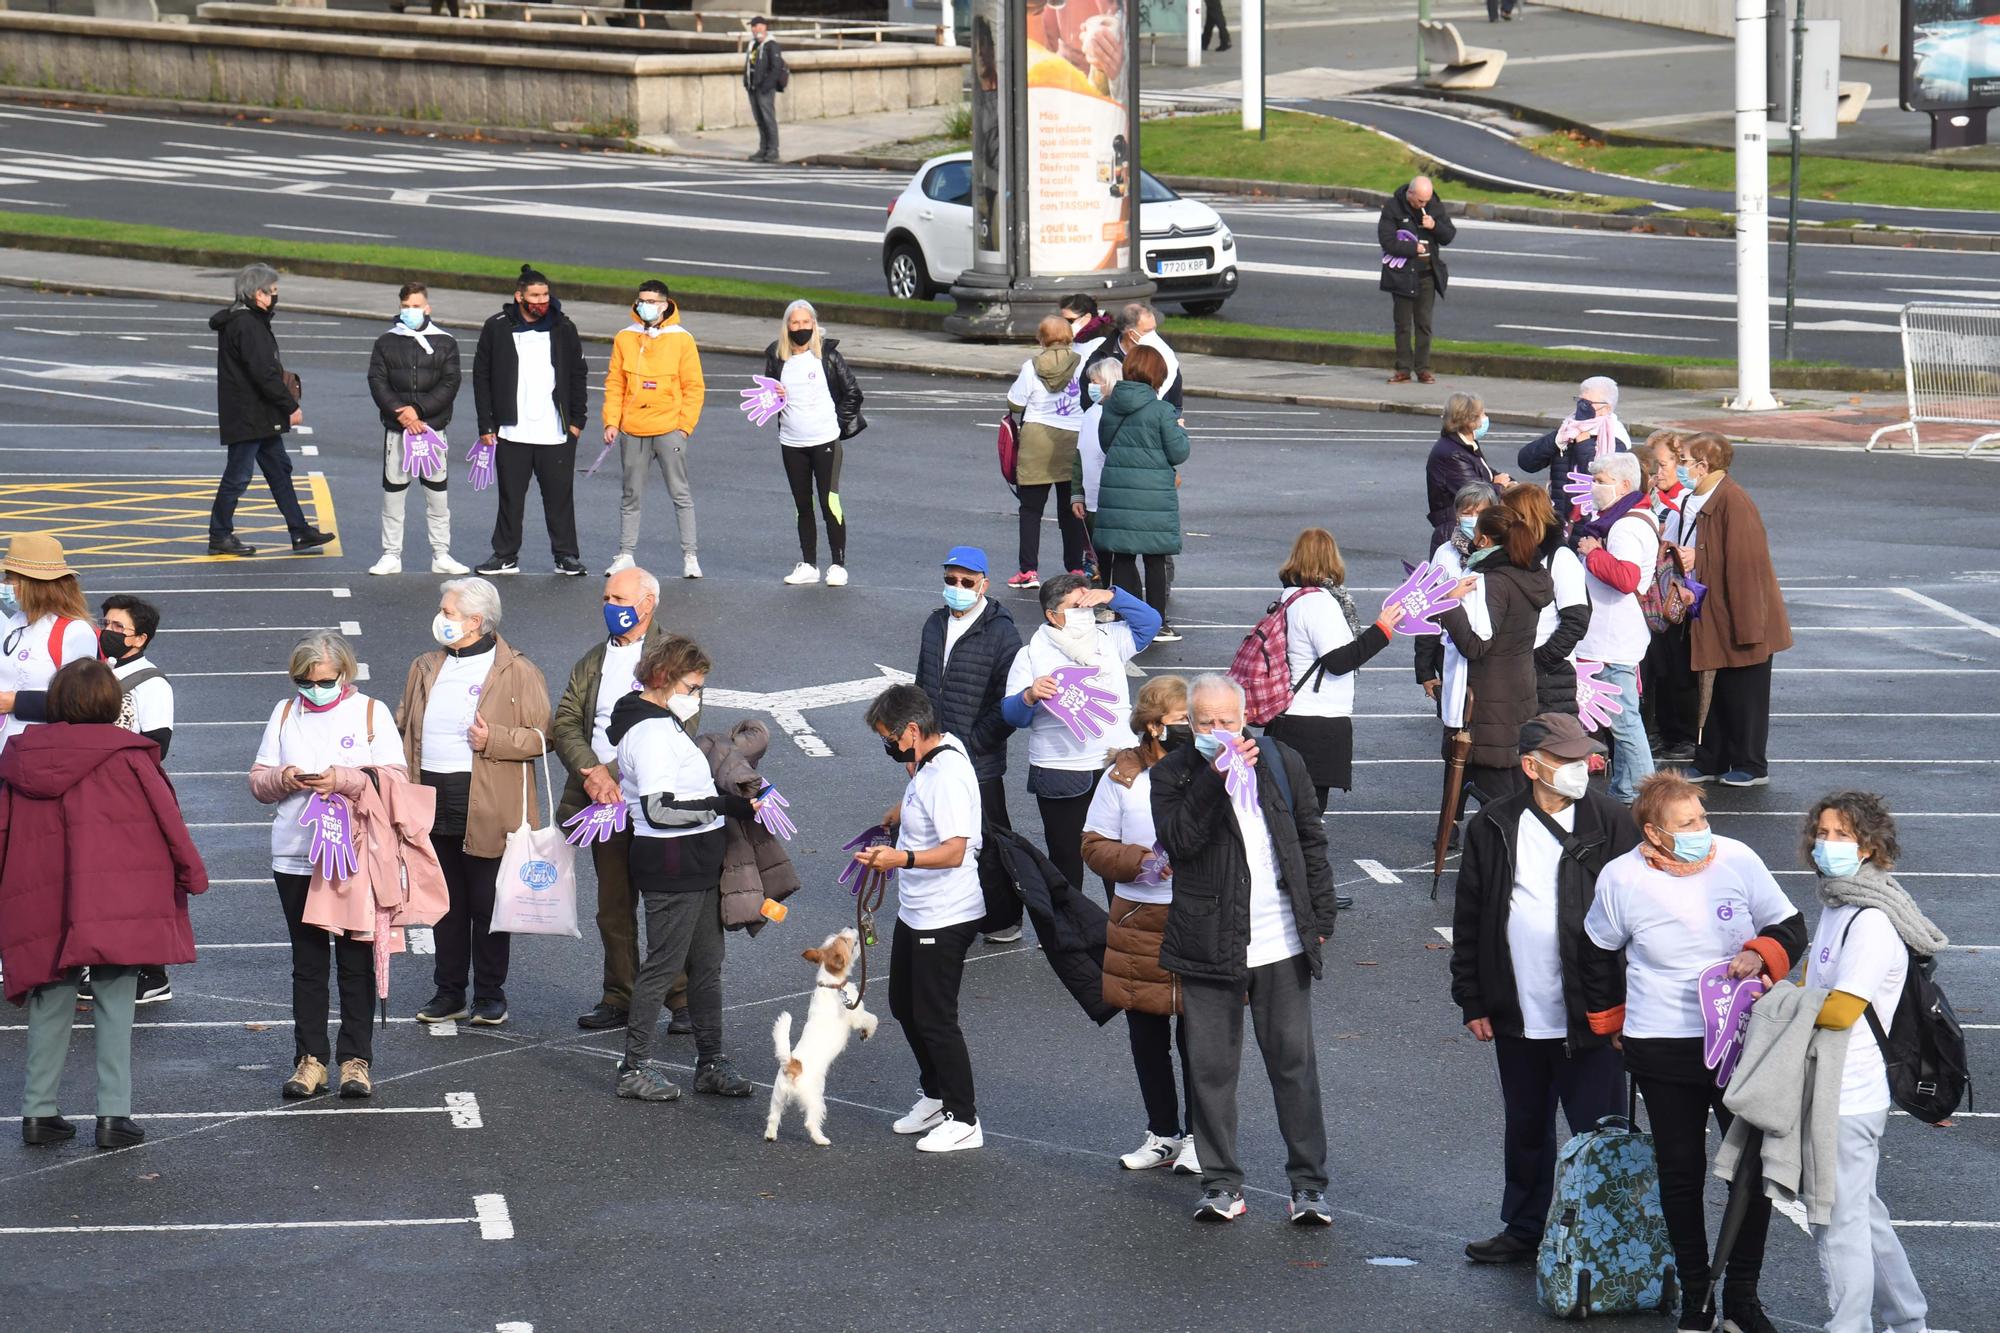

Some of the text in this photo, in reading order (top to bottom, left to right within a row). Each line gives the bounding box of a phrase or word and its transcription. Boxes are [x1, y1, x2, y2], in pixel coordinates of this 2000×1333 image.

[1040, 123, 1092, 133] variedades
[1040, 139, 1056, 147] que
[1081, 137, 1092, 146] de
[1040, 150, 1048, 159] la
[1040, 162, 1080, 172] Disfruta
[1040, 176, 1049, 184] tu
[1040, 202, 1057, 210] con
[1067, 223, 1079, 233] VA
[1048, 235, 1066, 243] SER
[1163, 260, 1204, 272] 7720 KBP
[1410, 588, 1431, 611] 25N
[1069, 690, 1089, 716] 25N
[322, 829, 343, 845] 25N
